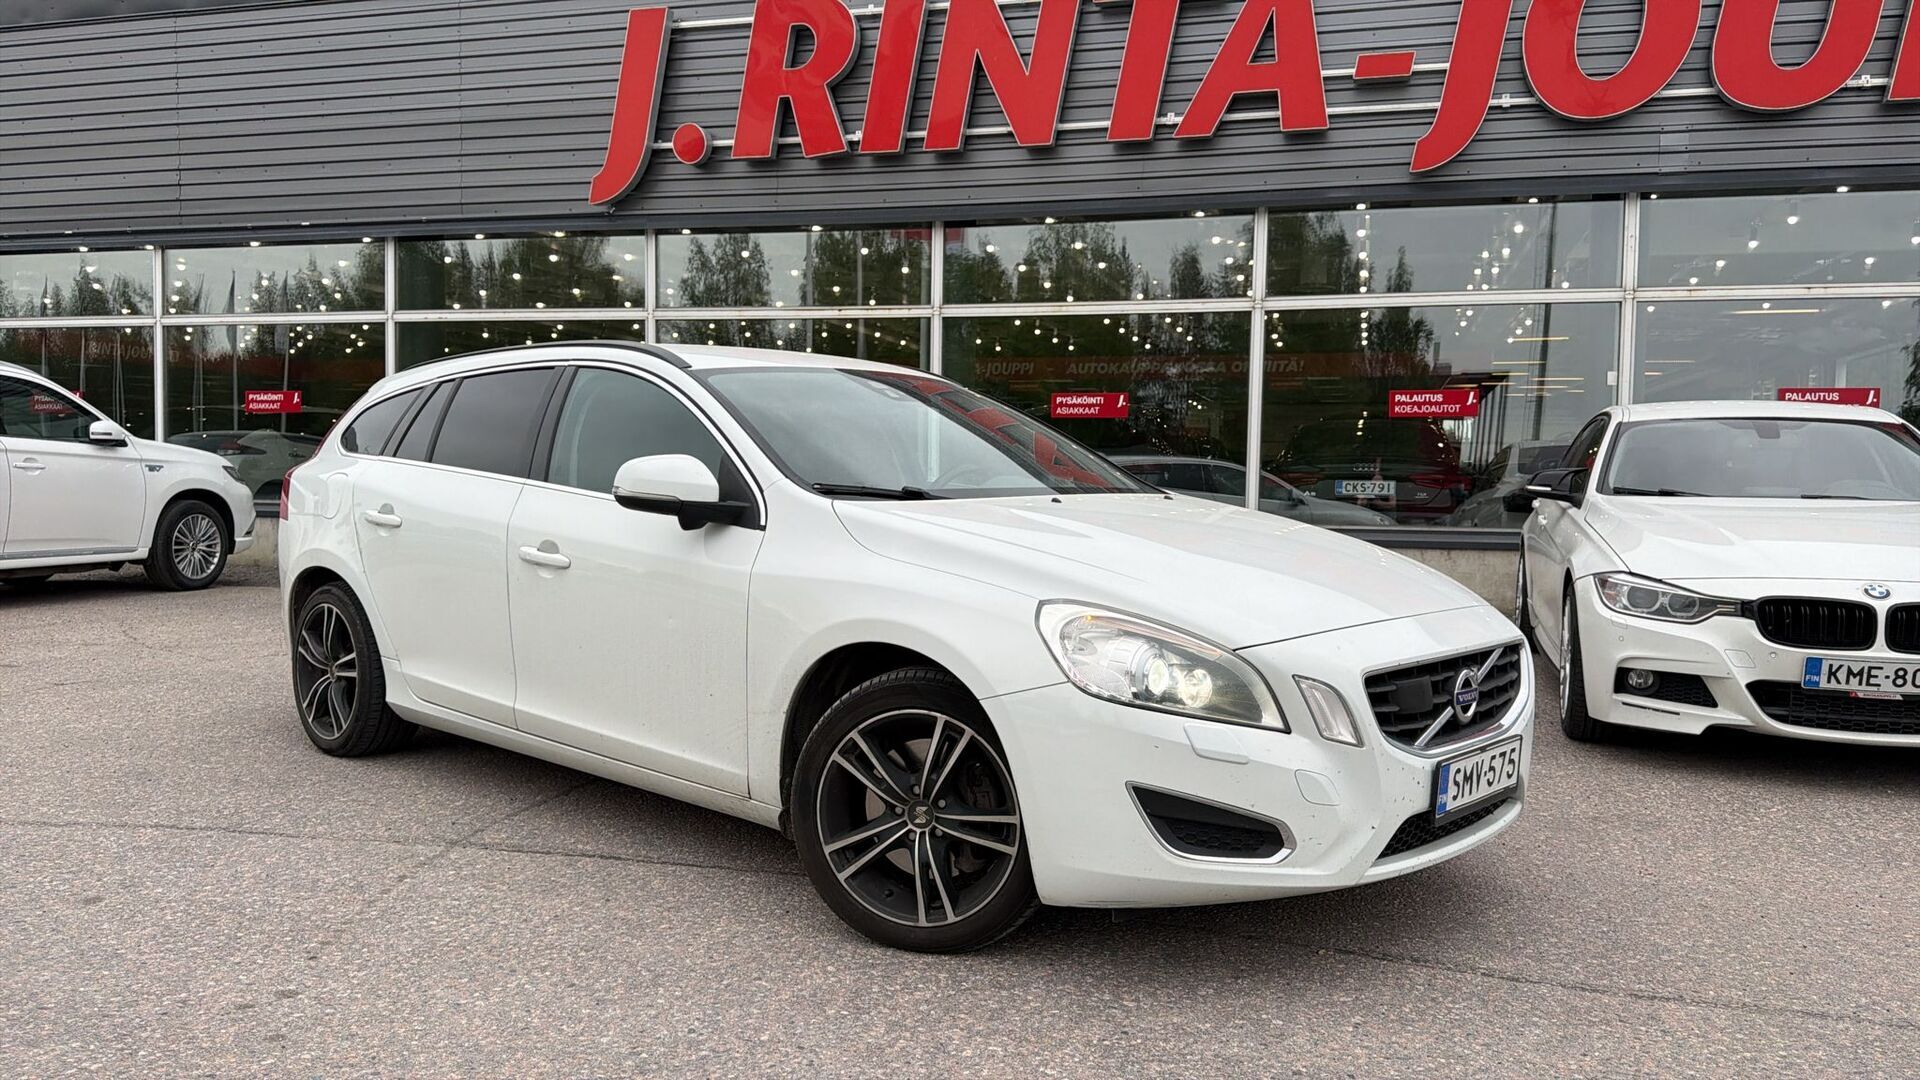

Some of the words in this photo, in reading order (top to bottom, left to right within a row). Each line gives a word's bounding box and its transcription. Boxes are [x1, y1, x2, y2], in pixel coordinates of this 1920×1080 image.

[588, 0, 1920, 204] J.RINTA-JOU
[248, 392, 284, 401] PYSÄKÖINTI
[1056, 395, 1104, 405] PYSÄKÖINTI
[1394, 393, 1444, 403] PALAUTUS
[1785, 392, 1840, 401] PALAUTUS
[248, 402, 281, 410] ASIAKKAAT
[1056, 406, 1100, 414] ASIAKKAAT
[1394, 404, 1462, 414] KOEAJOAUTOT
[1344, 482, 1392, 494] CKS-791
[1805, 674, 1820, 683] FIN
[1451, 746, 1517, 802] SMV-575
